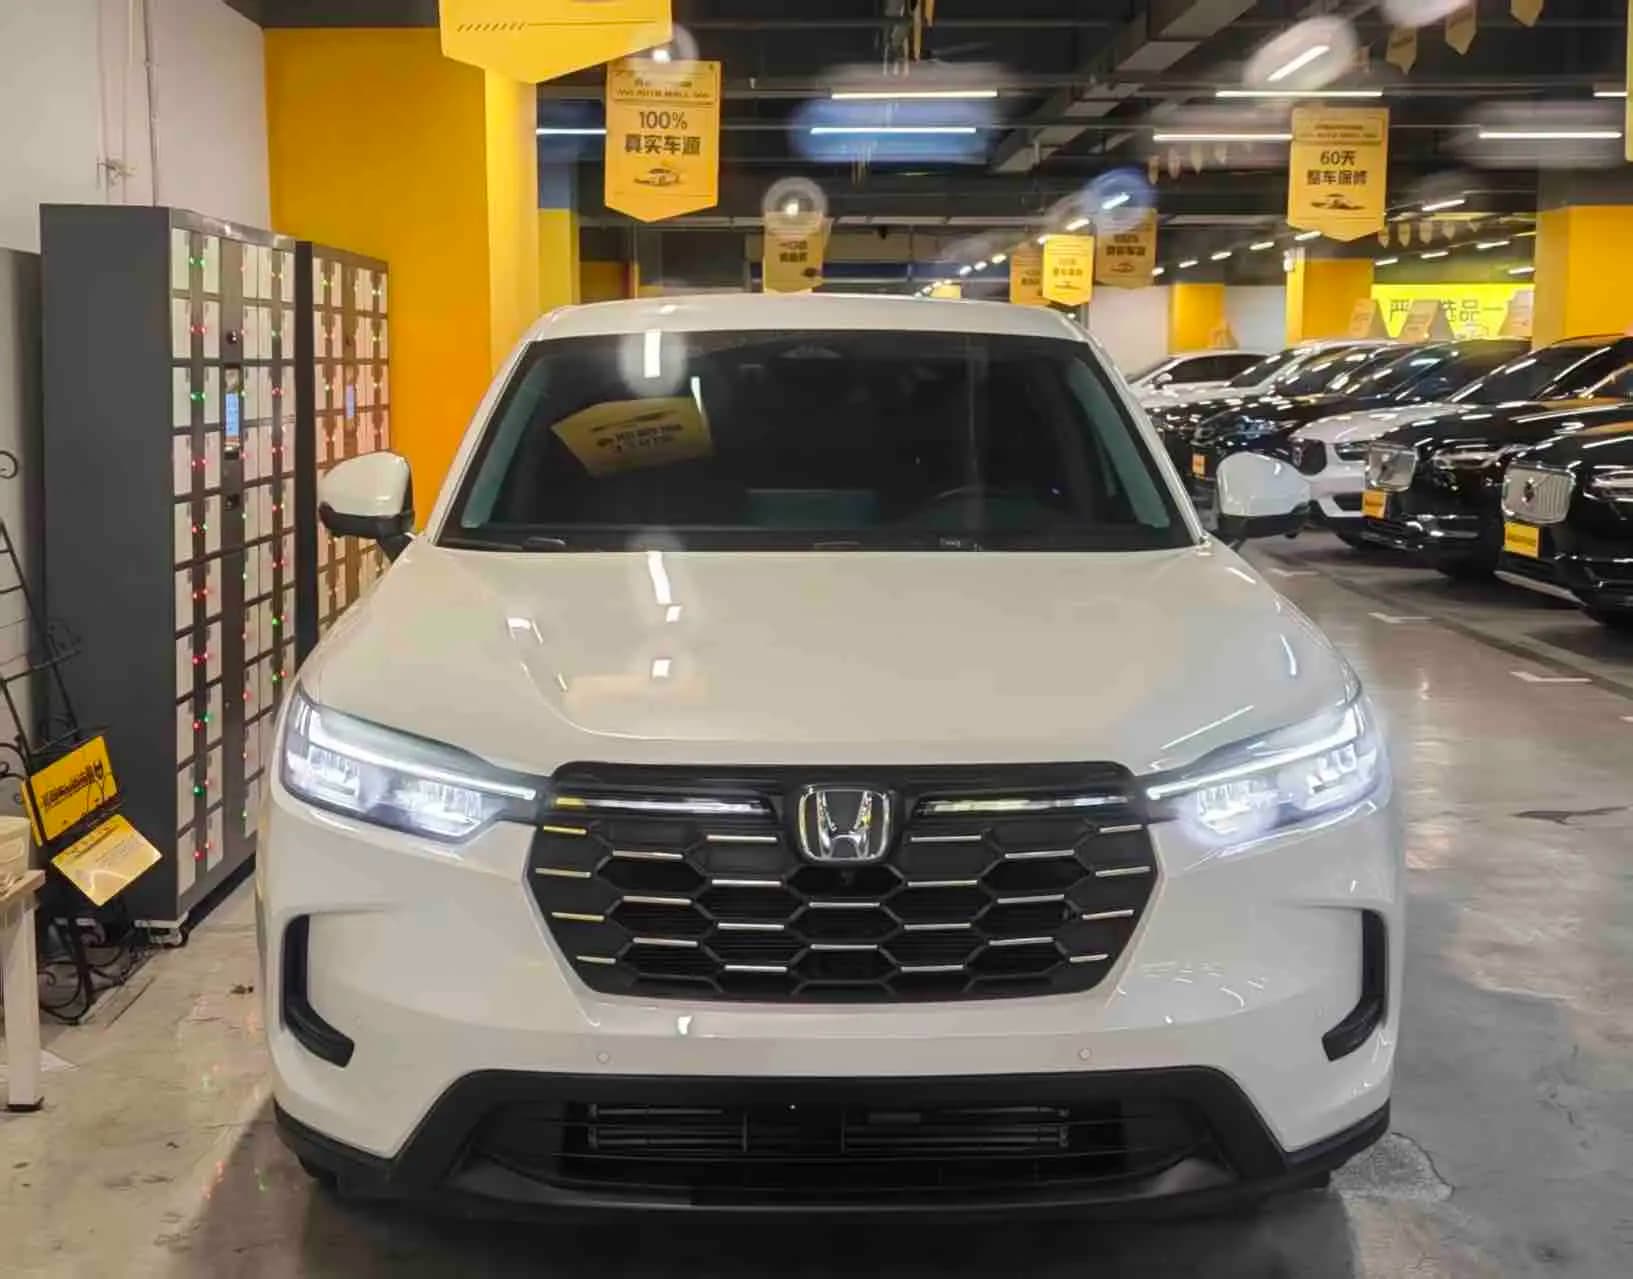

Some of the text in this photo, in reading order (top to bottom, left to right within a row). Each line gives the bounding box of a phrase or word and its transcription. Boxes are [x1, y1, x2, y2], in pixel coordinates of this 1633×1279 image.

[639, 111, 688, 130] 100%
[624, 133, 701, 156] 真实车源
[1319, 150, 1357, 166] 60天
